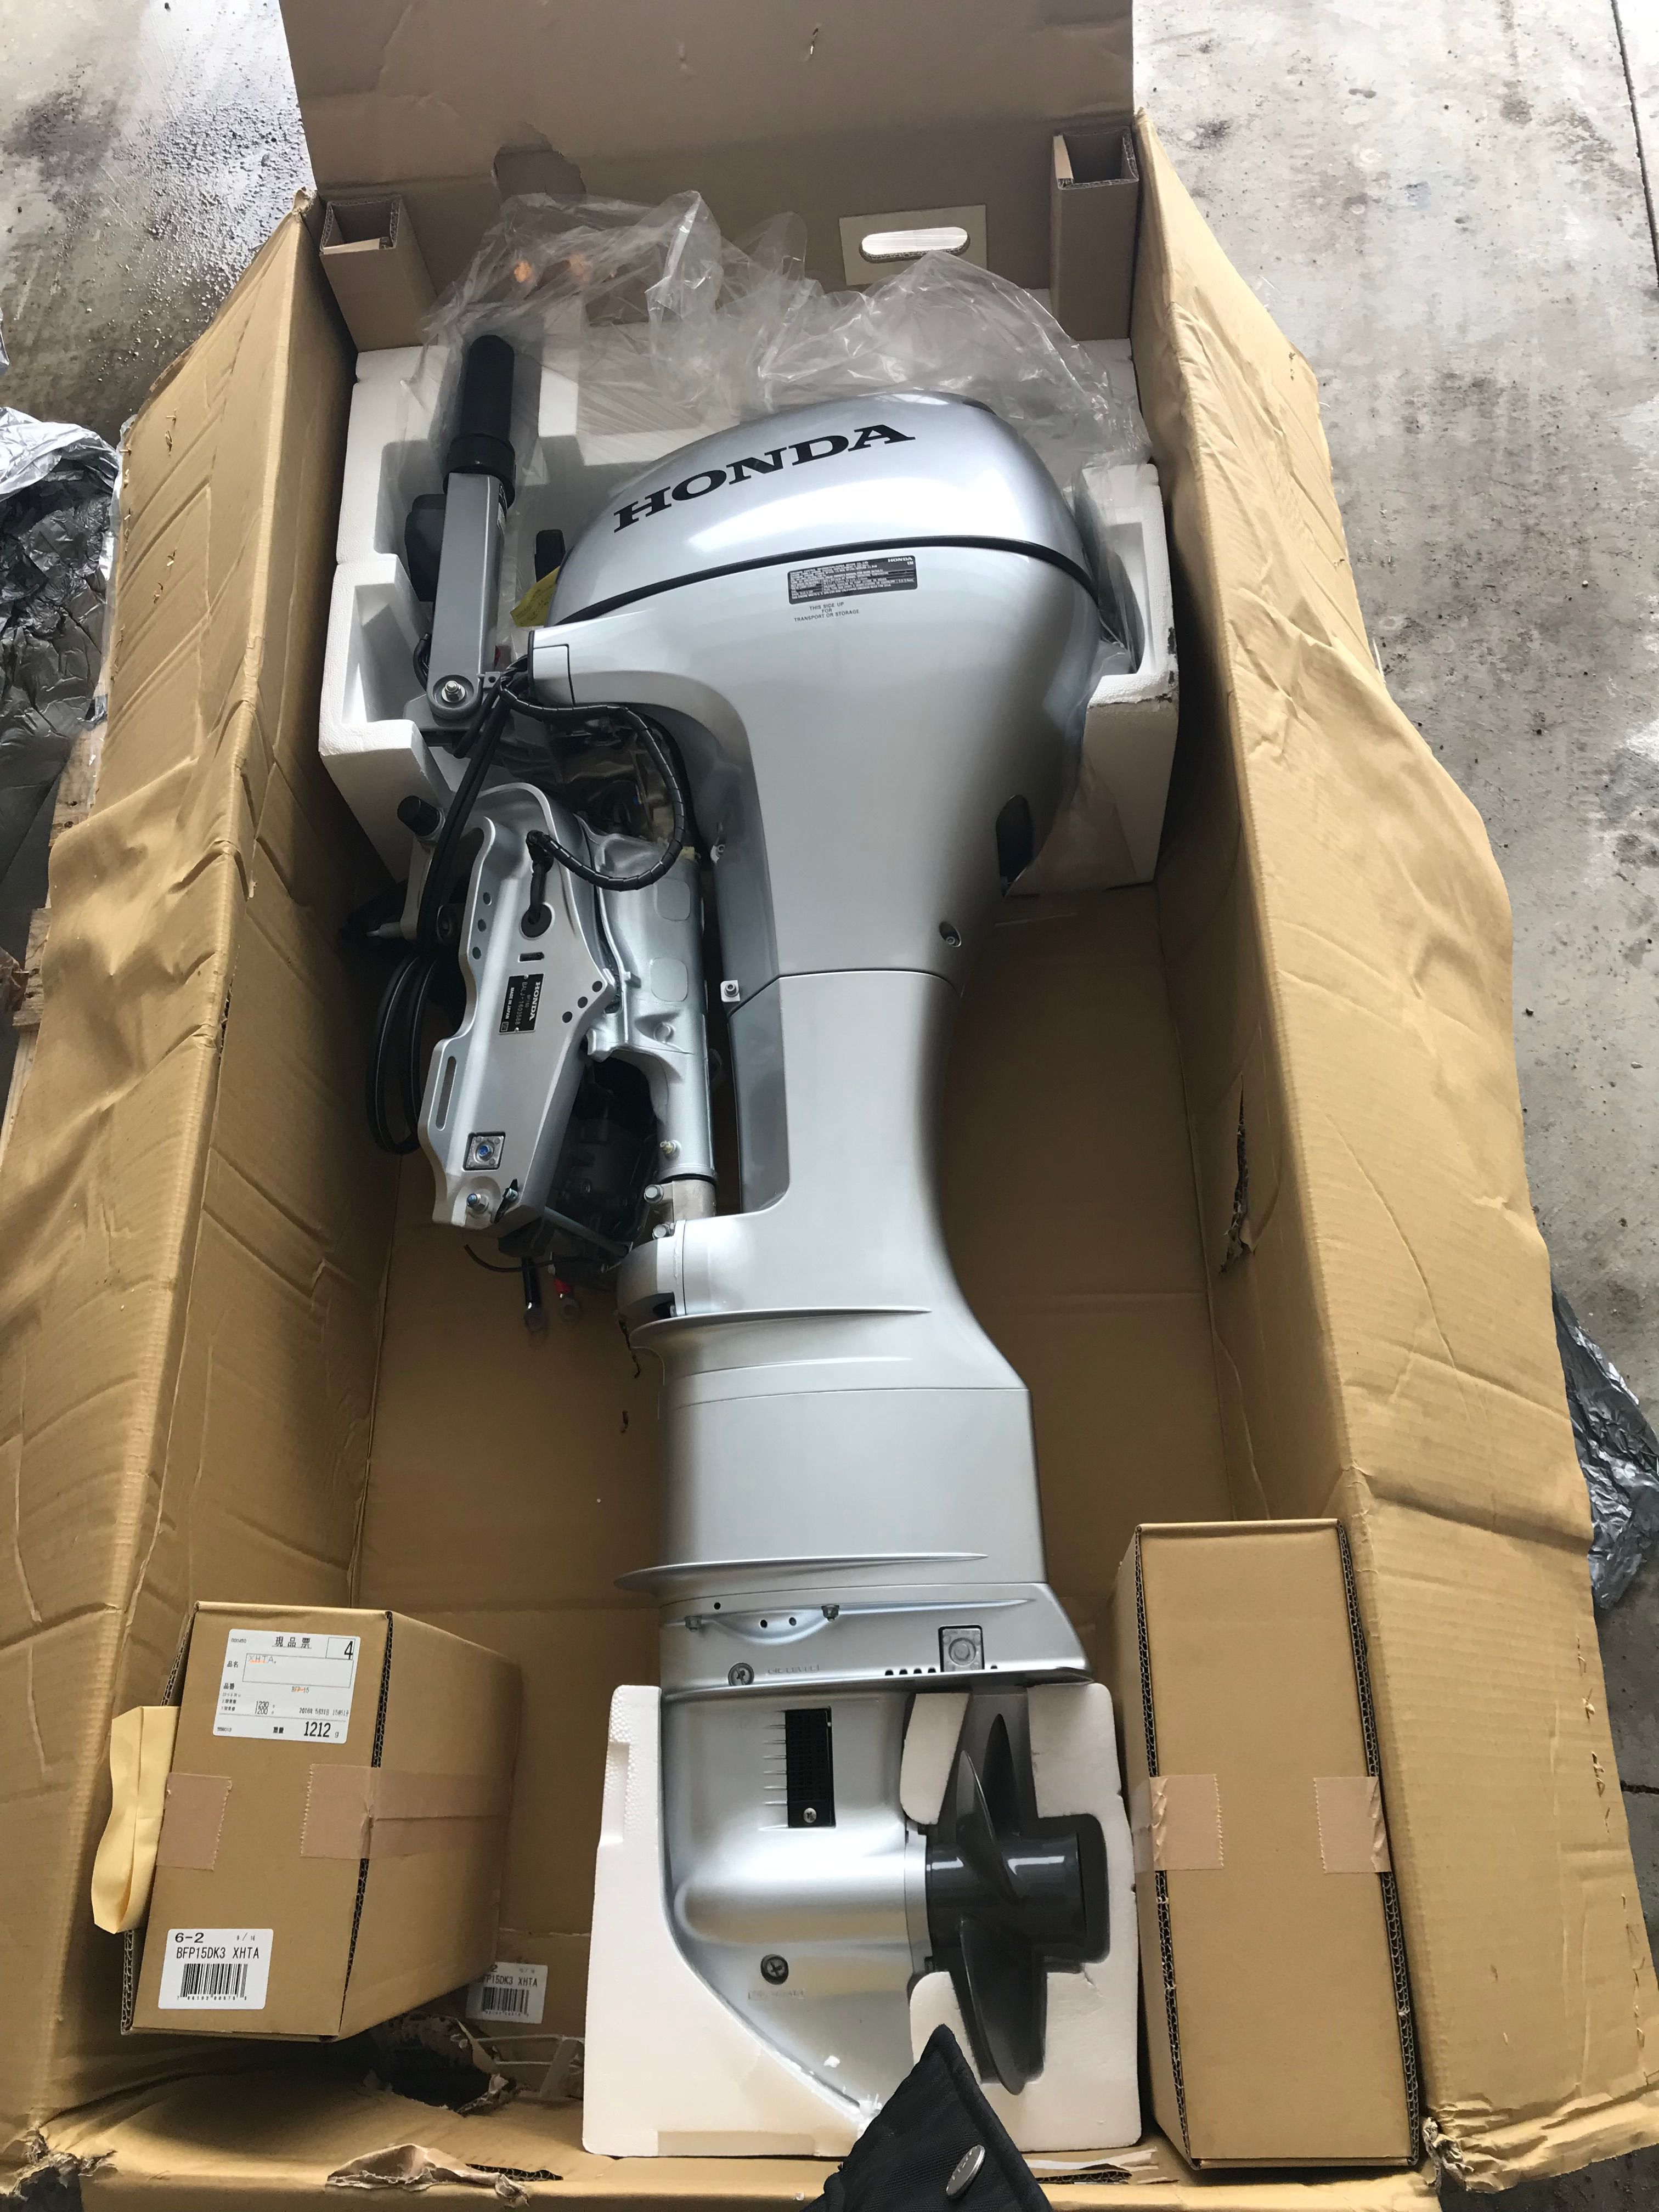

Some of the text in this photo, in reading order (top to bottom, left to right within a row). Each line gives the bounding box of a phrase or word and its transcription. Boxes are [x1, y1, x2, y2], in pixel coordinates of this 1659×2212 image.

[613, 425, 915, 533] HONDA
[794, 614, 825, 622] TRANSPORT
[529, 981, 541, 1020] HONDA
[275, 1637, 311, 1649] 現品票
[344, 1641, 353, 1660] 4
[304, 1721, 331, 1737] 1212
[175, 1932, 204, 1943] 6-2
[176, 1947, 259, 1959] BFP15DK3 XHTA
[518, 1977, 538, 1987] XHTA
